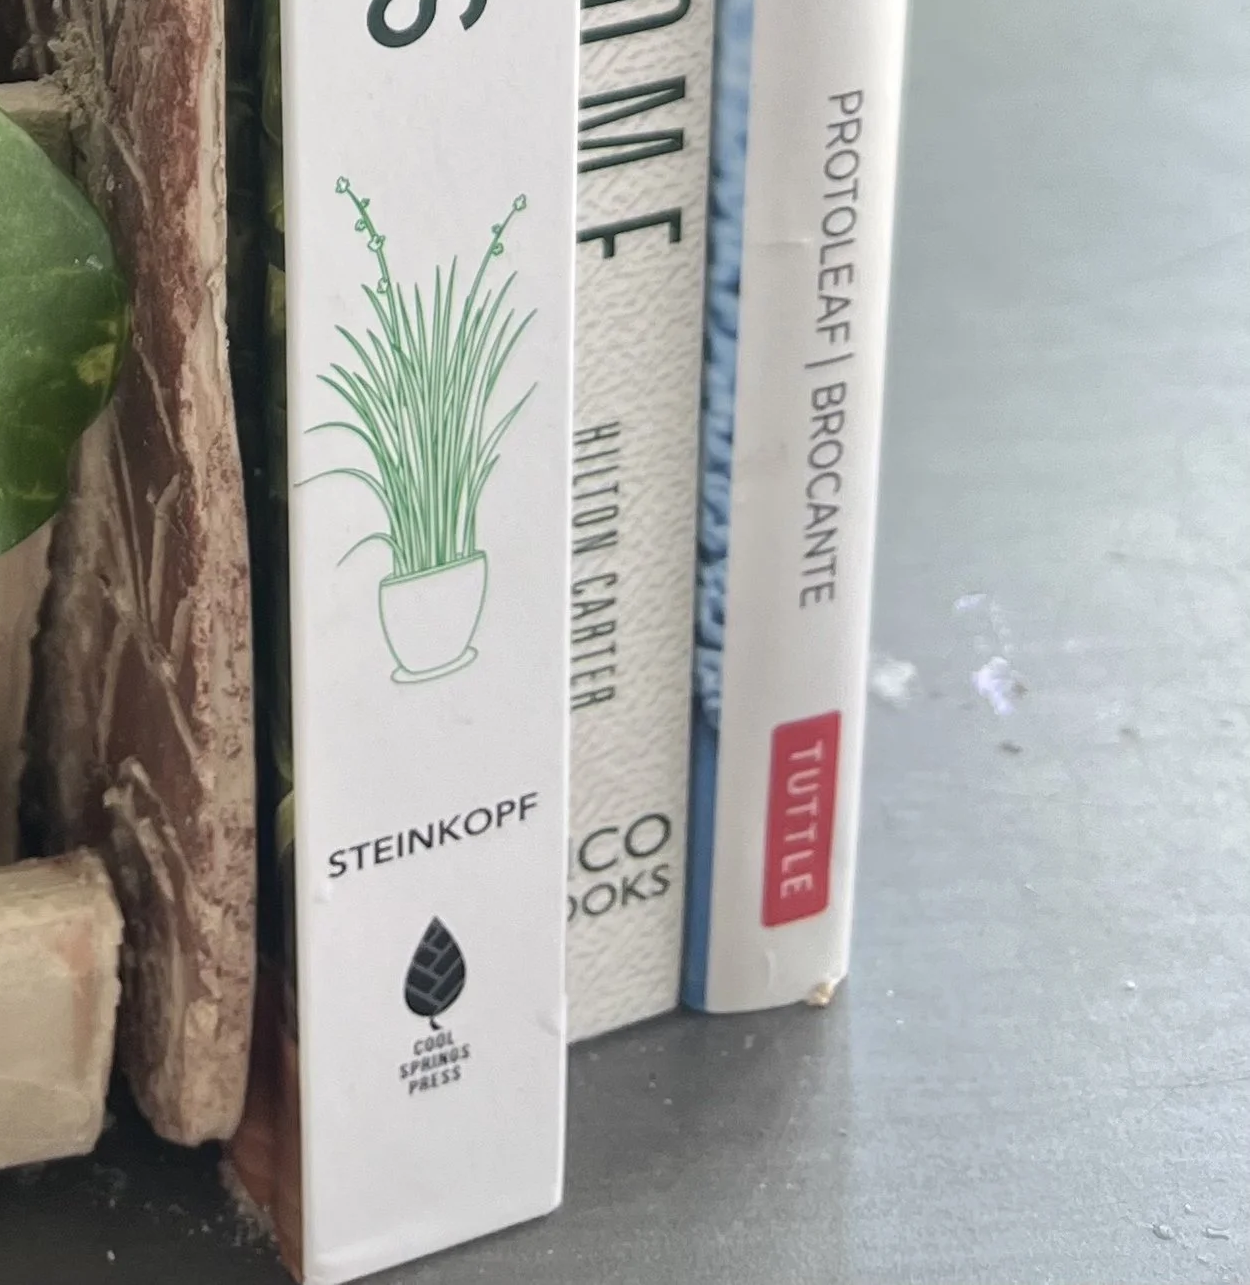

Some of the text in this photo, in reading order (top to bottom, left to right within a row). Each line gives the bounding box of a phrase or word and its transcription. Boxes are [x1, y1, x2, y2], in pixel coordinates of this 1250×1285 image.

[815, 89, 864, 344] PROTOLEAF
[798, 380, 847, 610] BROCANTE
[569, 420, 621, 710] HILTON CARTER
[328, 791, 539, 880] STEINKOPF
[568, 812, 672, 880] CO
[779, 738, 825, 899] TUTTLE
[400, 1043, 471, 1080] SPRINGS
[408, 1065, 461, 1096] PRESS
[413, 1030, 454, 1056] COOL
